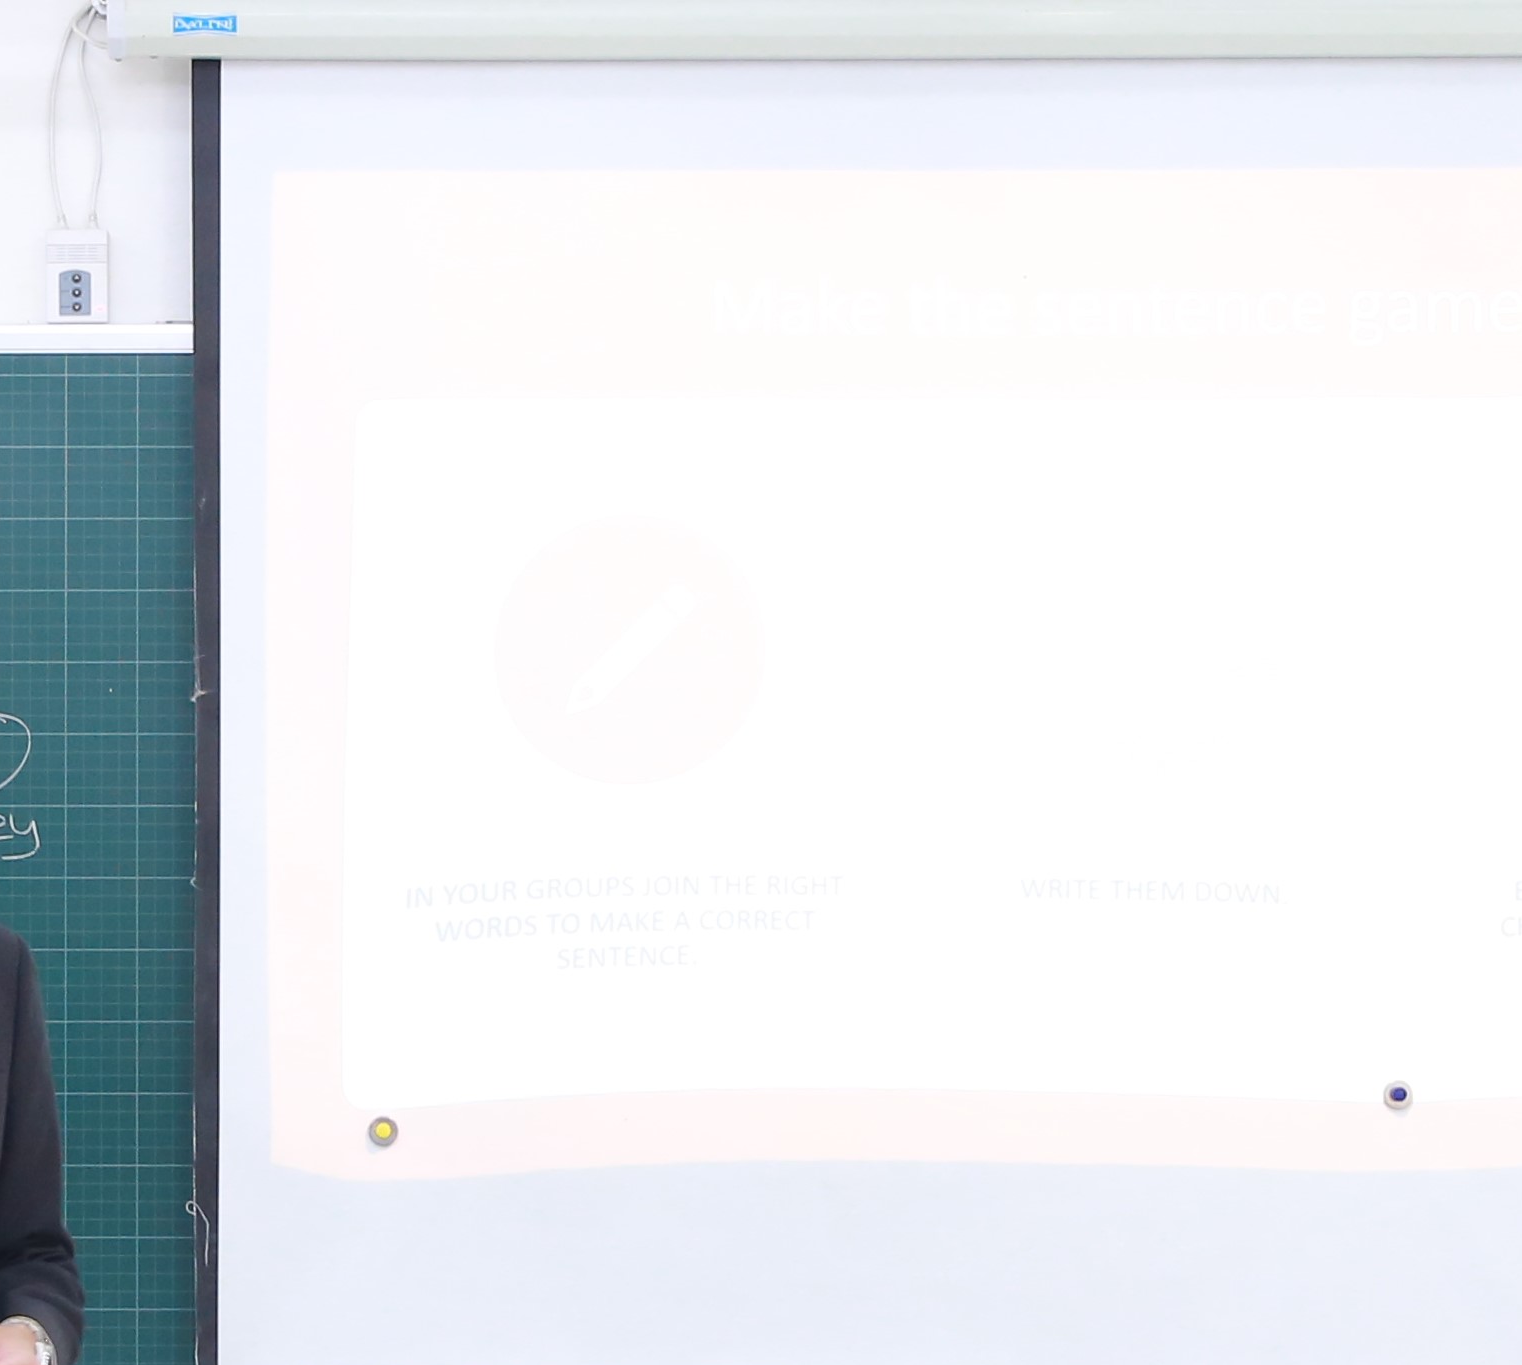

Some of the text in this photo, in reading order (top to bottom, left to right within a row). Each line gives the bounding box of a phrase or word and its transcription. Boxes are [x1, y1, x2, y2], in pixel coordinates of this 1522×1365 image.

[711, 274, 885, 335] Make
[906, 273, 1013, 335] the
[1033, 280, 1327, 335] sentence
[406, 874, 844, 910] IN YOUR GROUPS JOIN THE RIGHT
[1020, 878, 1100, 900] WRITE
[1110, 879, 1185, 901] THEM
[434, 909, 815, 943] WORDS TO MAKE A CORRECT
[556, 944, 698, 970] SENTENCE.
